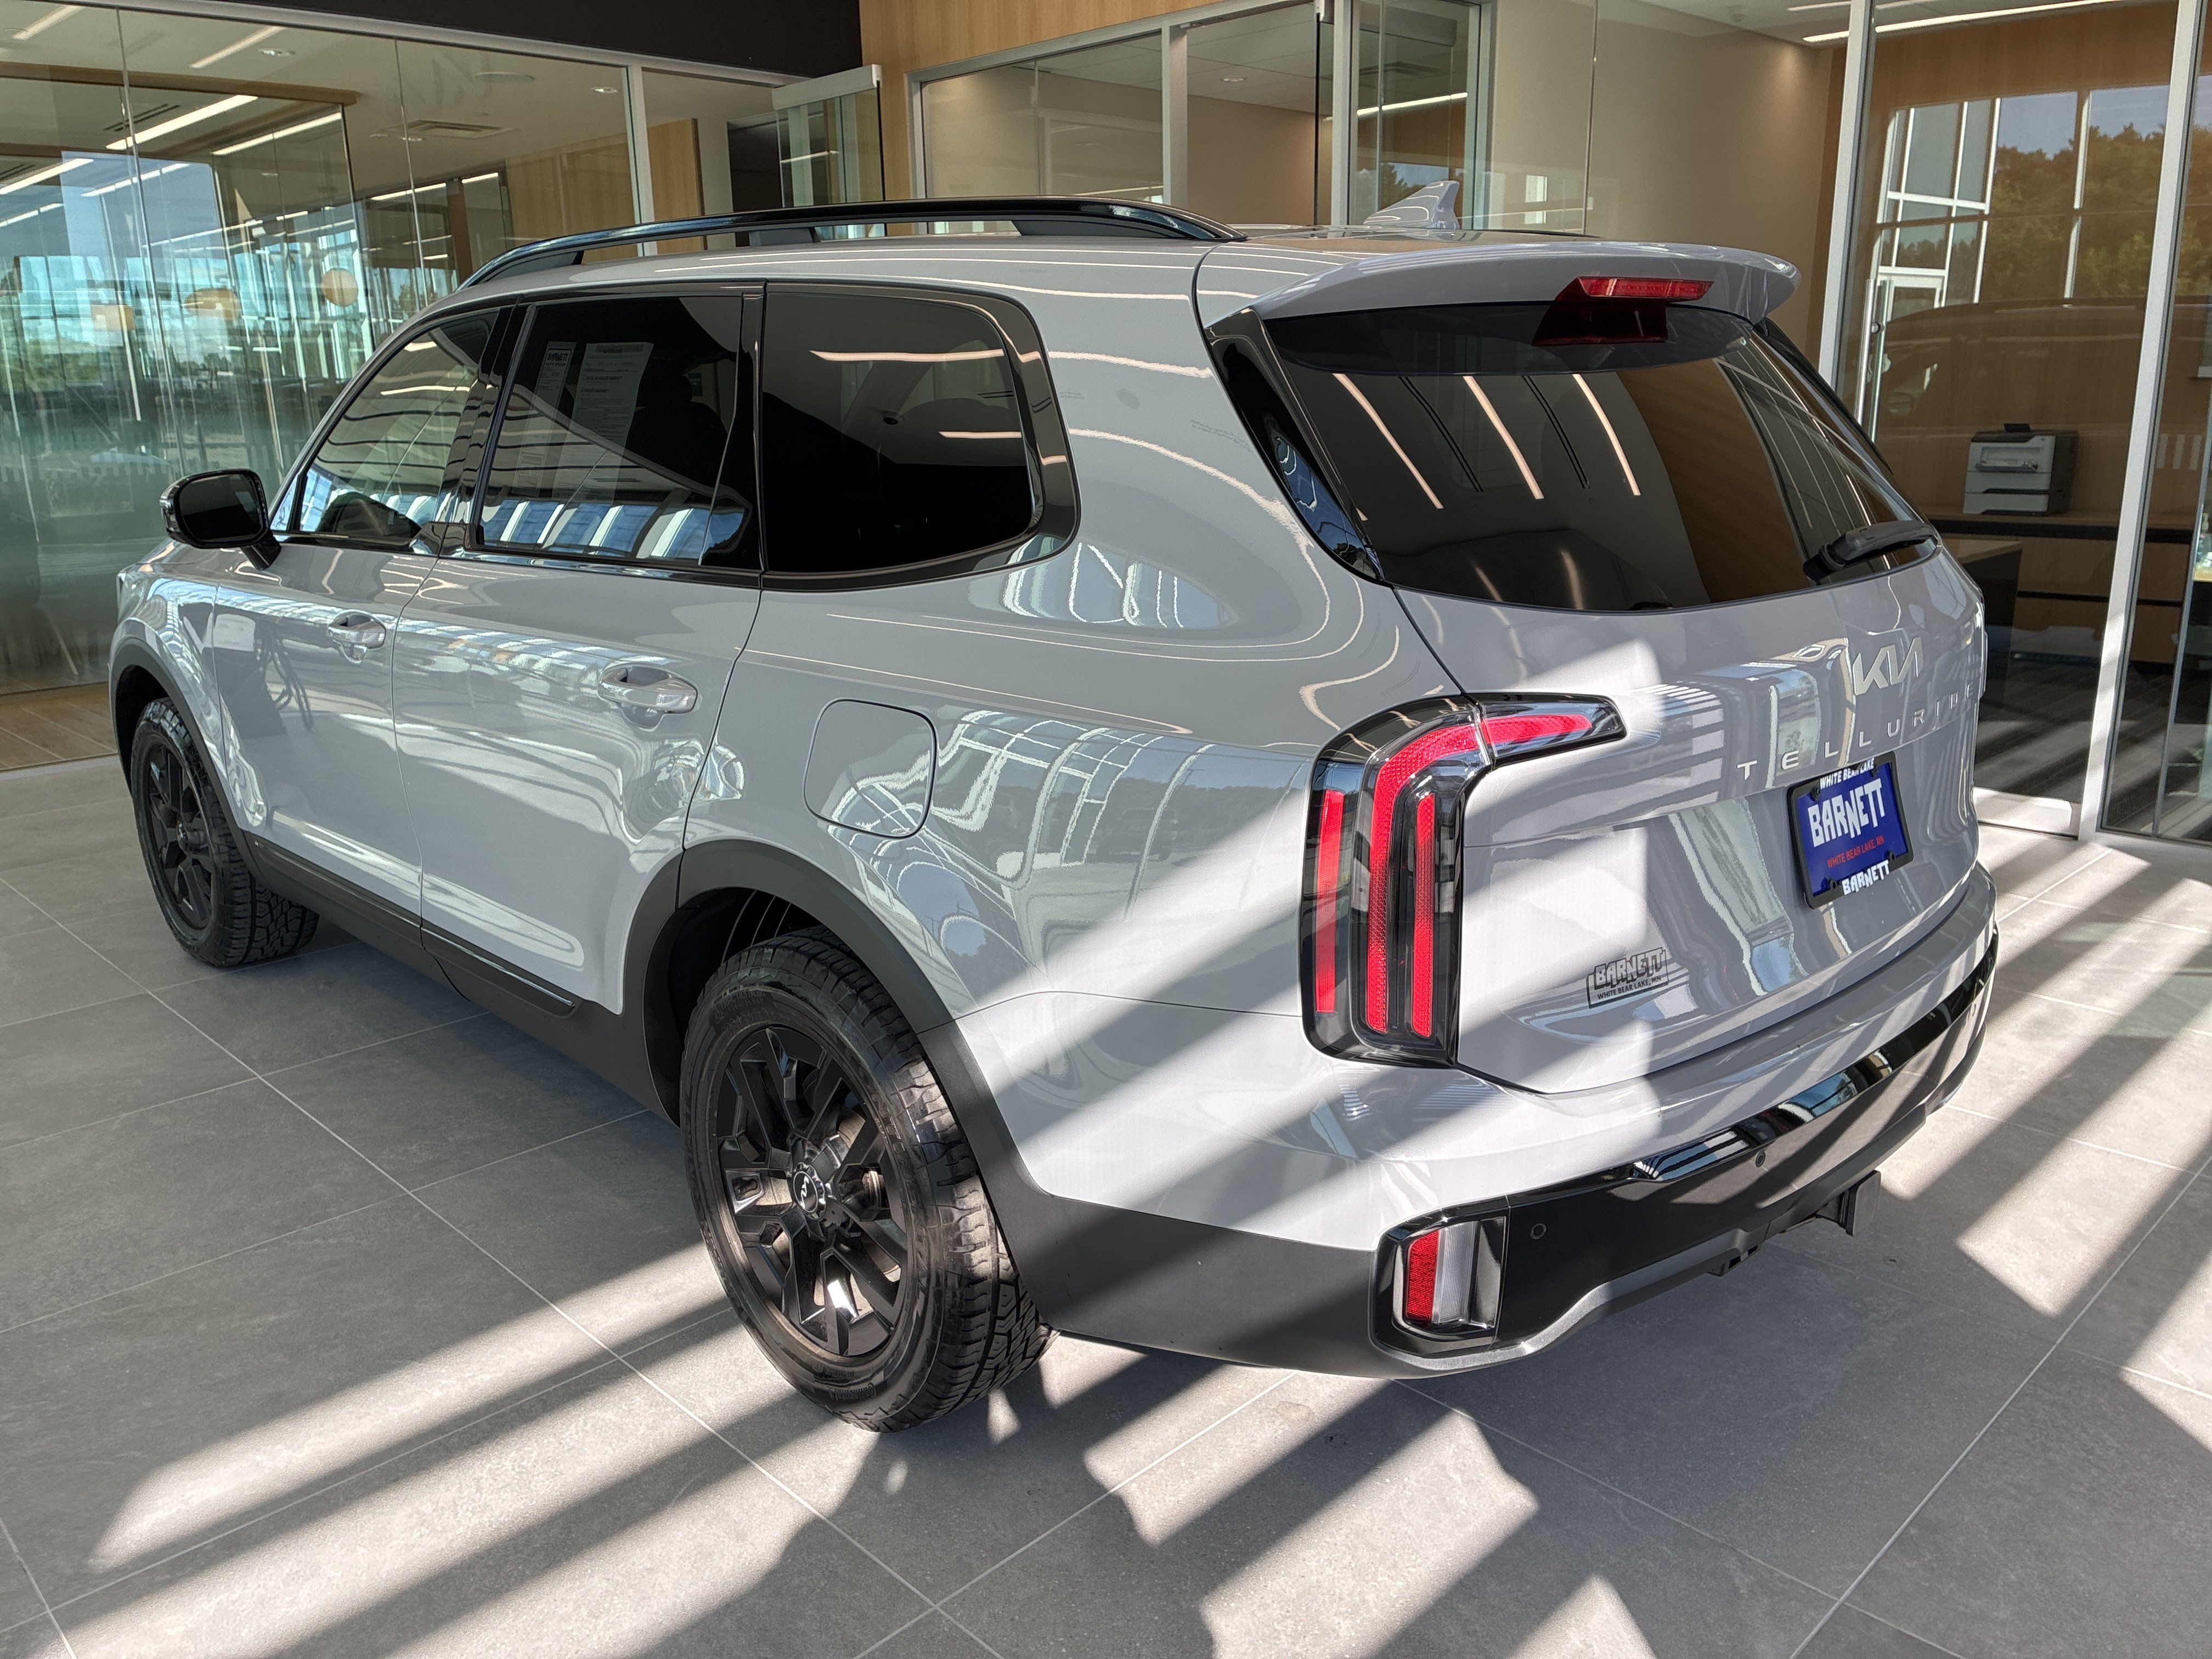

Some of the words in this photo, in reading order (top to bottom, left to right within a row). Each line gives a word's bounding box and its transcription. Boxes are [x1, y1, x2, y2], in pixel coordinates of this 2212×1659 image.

[1852, 637, 1924, 696] KIA
[1737, 681, 1975, 780] TELLURIDE
[1820, 770, 1842, 789] WHITE
[1843, 768, 1859, 781] BEAR
[1860, 757, 1875, 774] LAKE
[1808, 778, 1885, 848] BARNETT
[1827, 855, 1846, 868] WHITE
[1846, 846, 1861, 860] BEAR
[1876, 834, 1885, 847] MN
[1842, 859, 1889, 895] BARNETT
[1594, 947, 1664, 990] BARNETT
[1597, 989, 1617, 1000] WHITE
[1618, 984, 1633, 994] BEAR
[1634, 979, 1651, 990] LAKE,
[1652, 975, 1662, 985] MN
